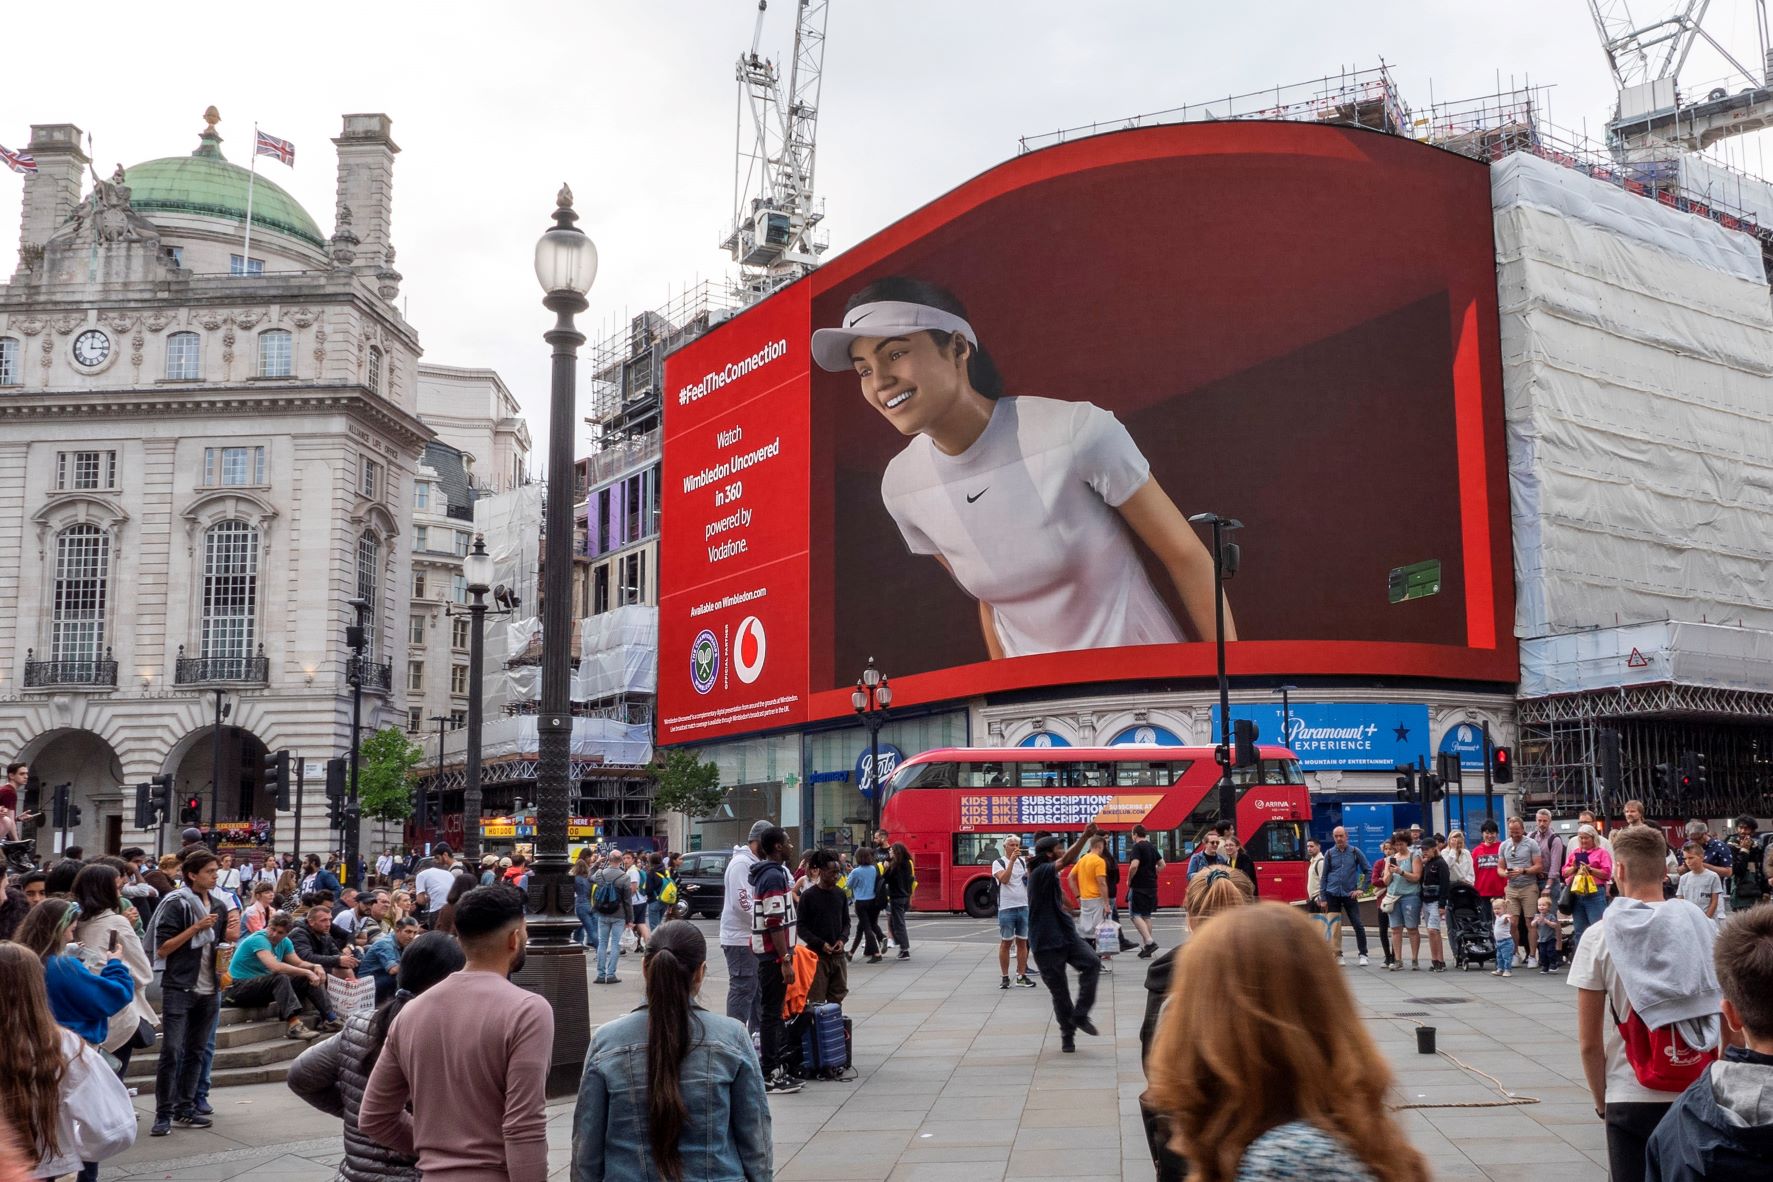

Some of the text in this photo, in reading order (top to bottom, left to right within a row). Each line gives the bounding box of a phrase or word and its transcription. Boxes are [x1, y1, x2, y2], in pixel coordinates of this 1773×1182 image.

[679, 339, 787, 406] #FeelTheConnection
[716, 425, 742, 449] Watch
[683, 436, 780, 494] Wimbledon Uncovered
[715, 481, 743, 507] in 360
[705, 507, 752, 542] powered by
[707, 539, 748, 563] Vodafone.
[690, 587, 767, 617] Available on Wimbledon.com
[1278, 717, 1378, 744] Paramount+
[1295, 741, 1372, 750] EXPERIENCE
[808, 770, 849, 785] pharmacy
[961, 795, 1113, 806] KIDS BIKE SUBSCRIPTIONS
[961, 806, 988, 815] KIDS
[992, 806, 1018, 815] BIKE
[961, 815, 988, 825] KIDS
[992, 815, 1018, 825] BIKE
